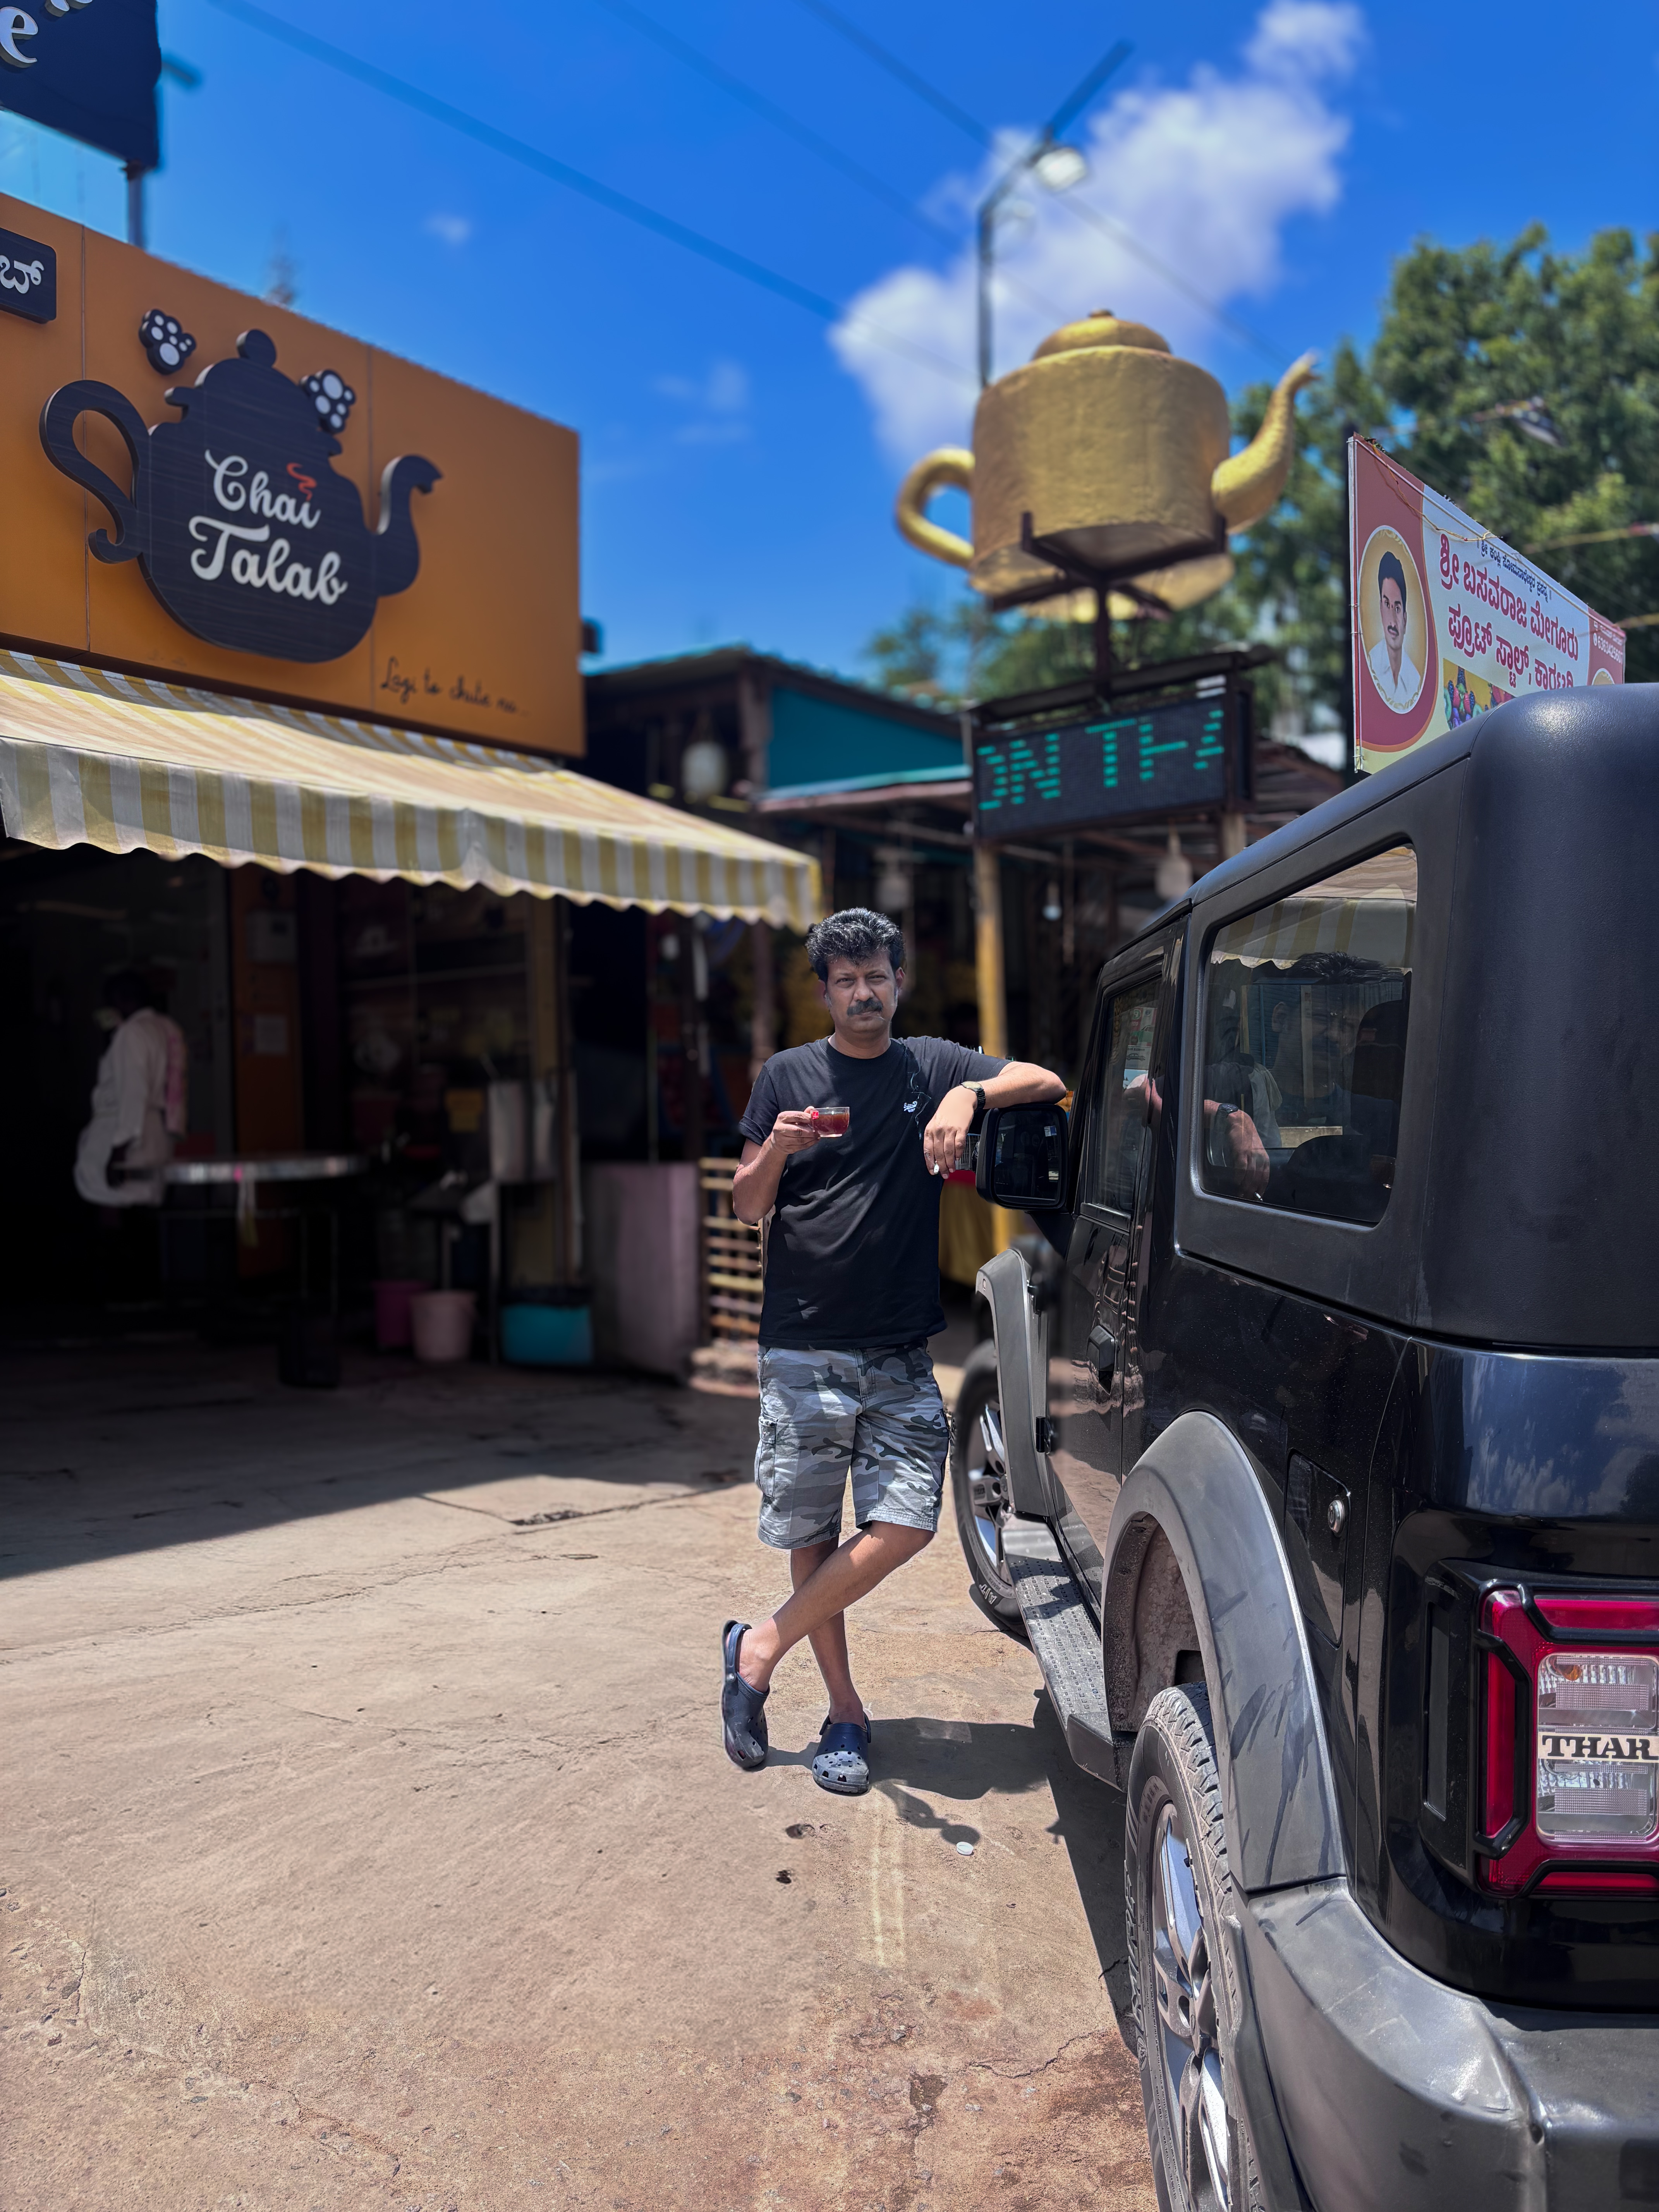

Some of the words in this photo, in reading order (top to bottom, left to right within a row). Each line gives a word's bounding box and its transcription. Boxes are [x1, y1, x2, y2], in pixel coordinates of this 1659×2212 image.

[204, 449, 321, 529] Chai
[189, 515, 348, 605] Talab
[1440, 534, 1459, 590] ಶ್ರೀ
[1463, 561, 1527, 628] ಬಸವರಾಜ
[1530, 600, 1578, 661] ಮೇಗೂರು
[1542, 1735, 1659, 1760] THAR
